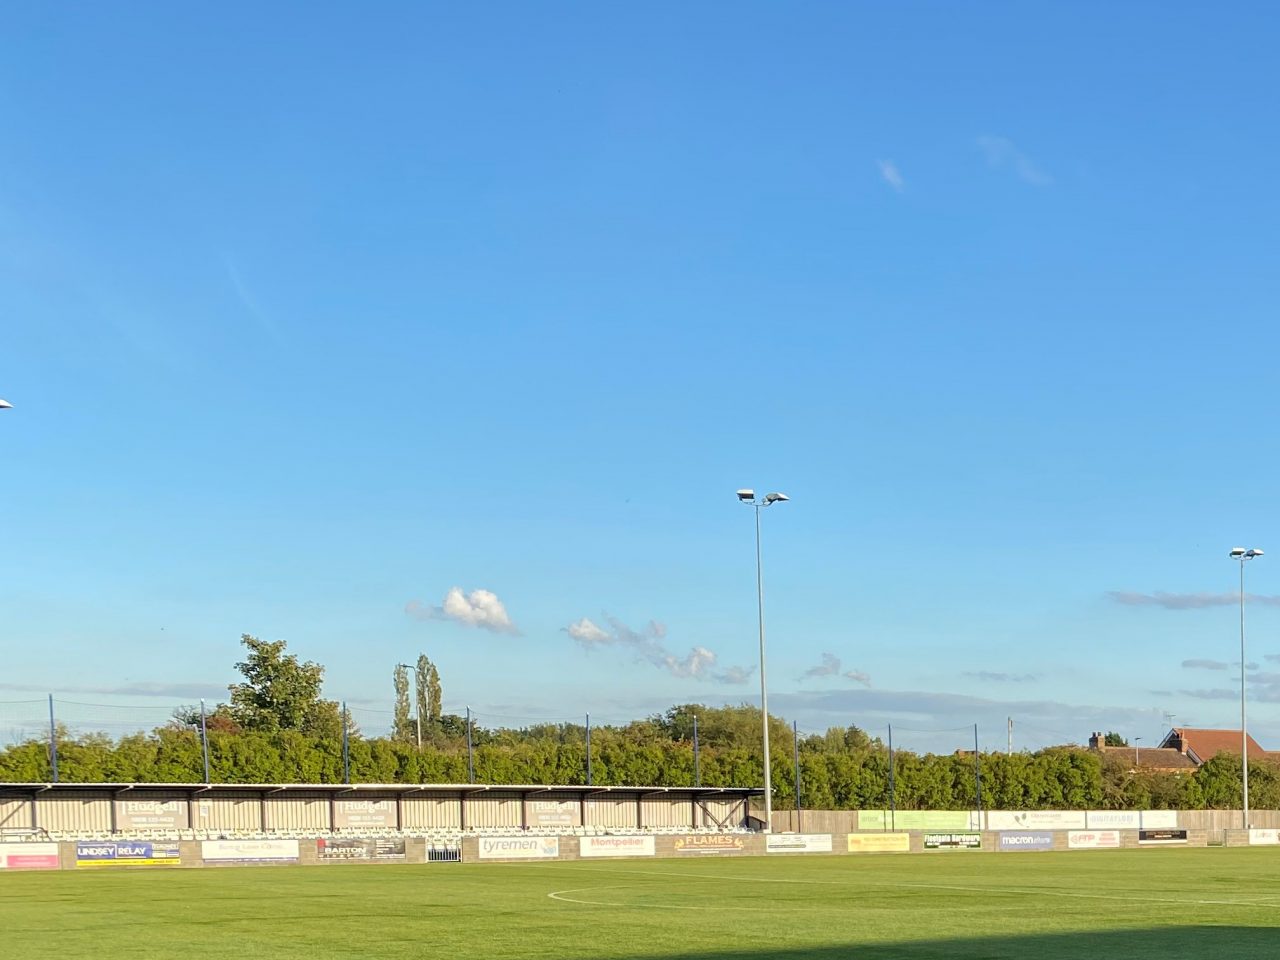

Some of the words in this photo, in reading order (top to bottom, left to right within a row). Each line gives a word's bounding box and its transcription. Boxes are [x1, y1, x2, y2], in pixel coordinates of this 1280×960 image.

[483, 838, 537, 852] tyremen
[685, 836, 733, 845] FLAMES
[1002, 836, 1033, 845] macron
[78, 847, 114, 856] LINDSEY
[118, 846, 146, 855] RELAY
